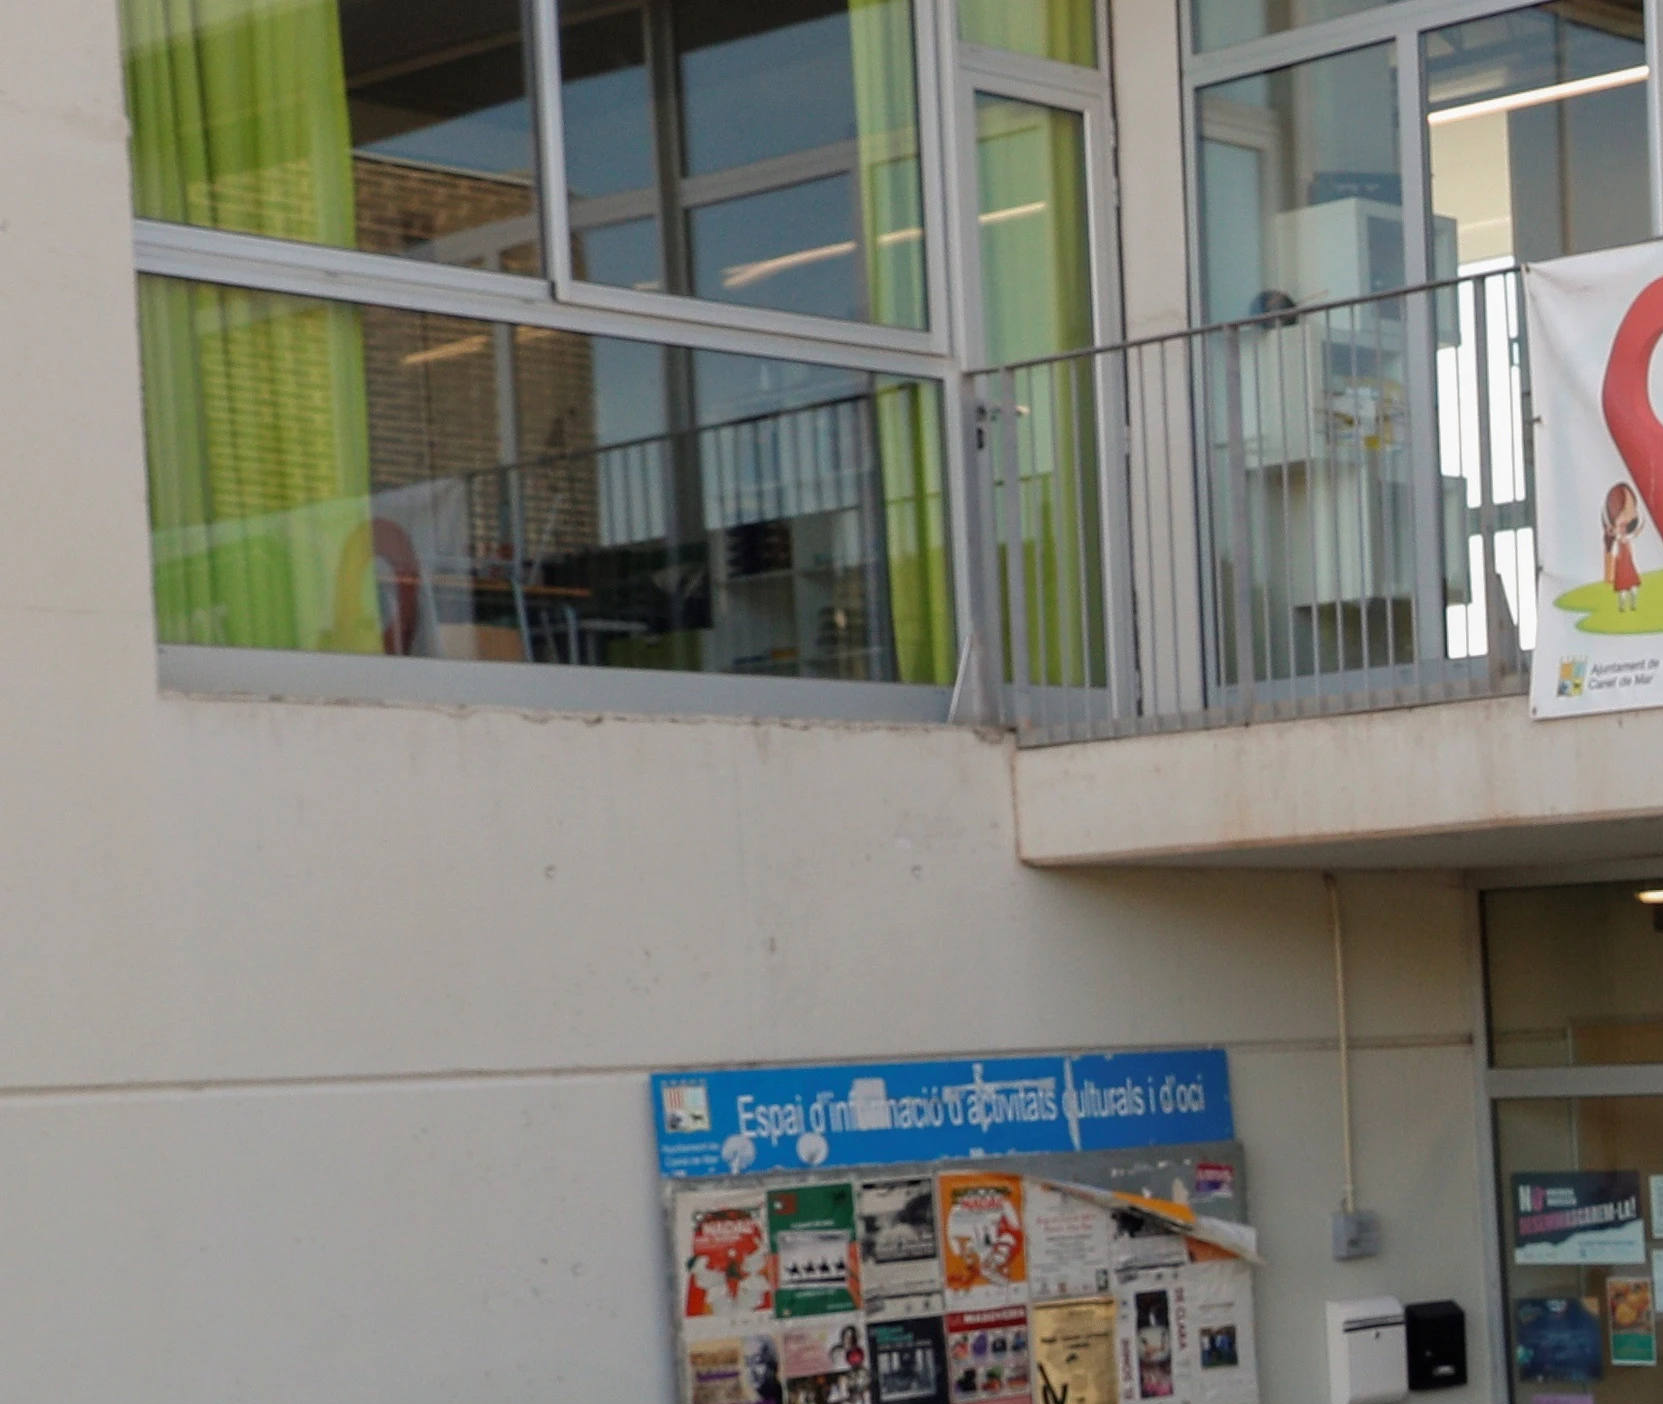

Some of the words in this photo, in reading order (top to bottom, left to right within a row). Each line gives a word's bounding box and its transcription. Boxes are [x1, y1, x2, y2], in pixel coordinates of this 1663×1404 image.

[1634, 673, 1654, 685] Mar
[736, 1093, 806, 1147] Espai
[1147, 1076, 1156, 1114] i
[1160, 1074, 1206, 1114] d'oci
